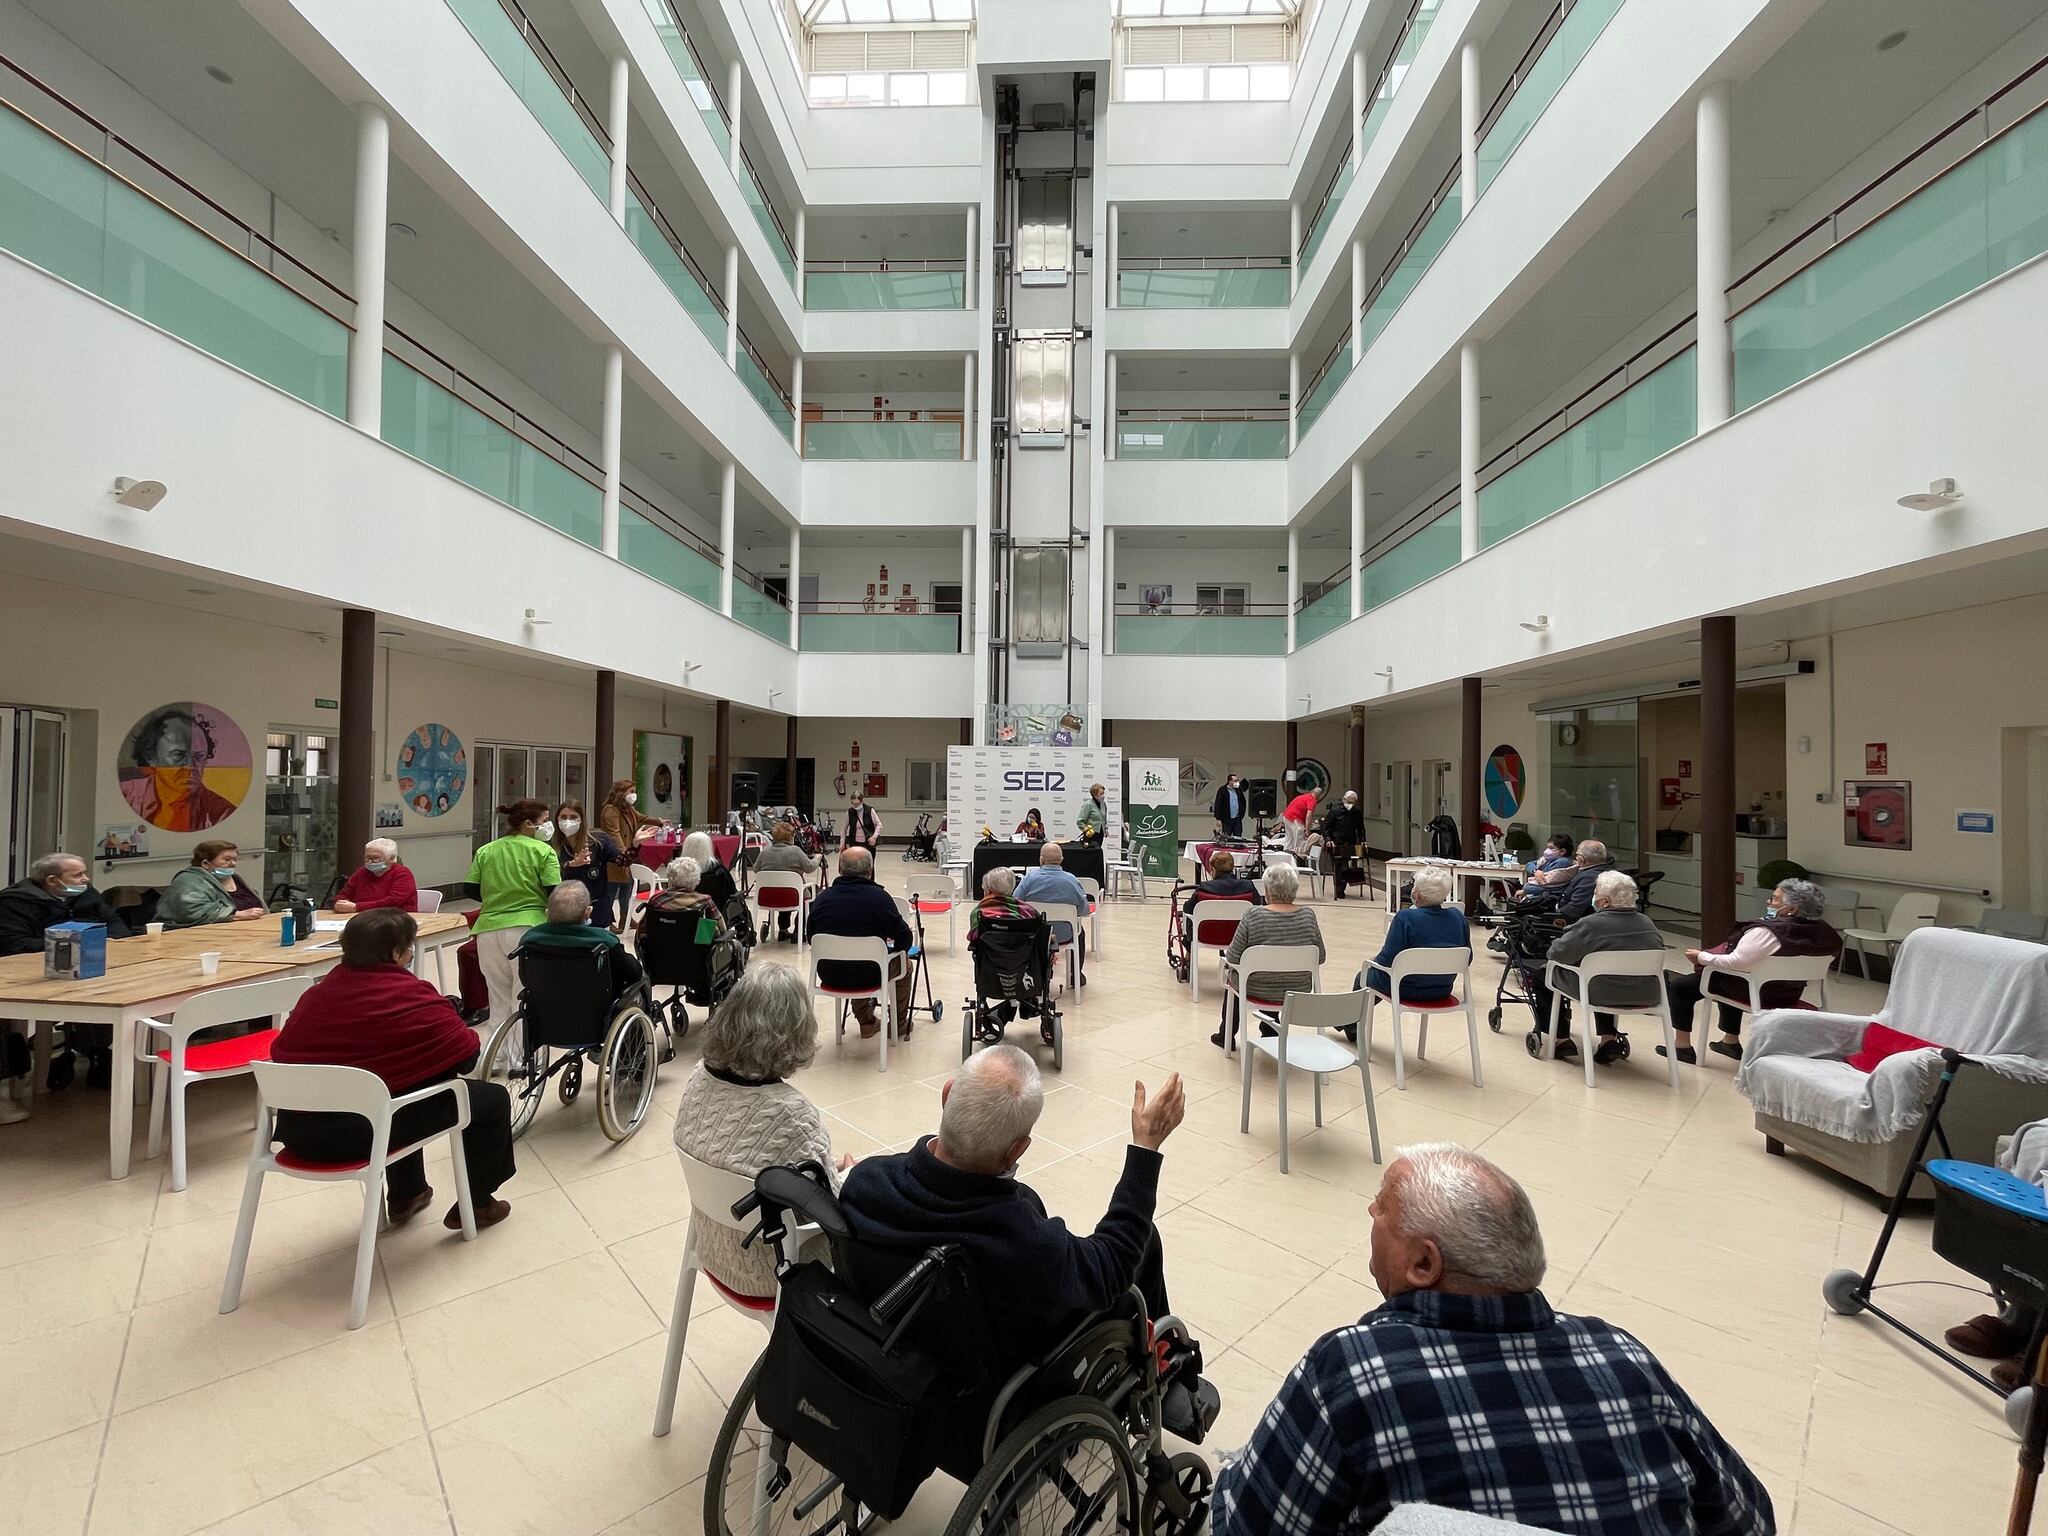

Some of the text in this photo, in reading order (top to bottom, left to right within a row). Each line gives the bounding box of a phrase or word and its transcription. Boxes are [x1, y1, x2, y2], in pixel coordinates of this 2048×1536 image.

[1003, 771, 1066, 791] SER
[1136, 814, 1167, 830] 50
[1096, 1363, 1118, 1391] karma
